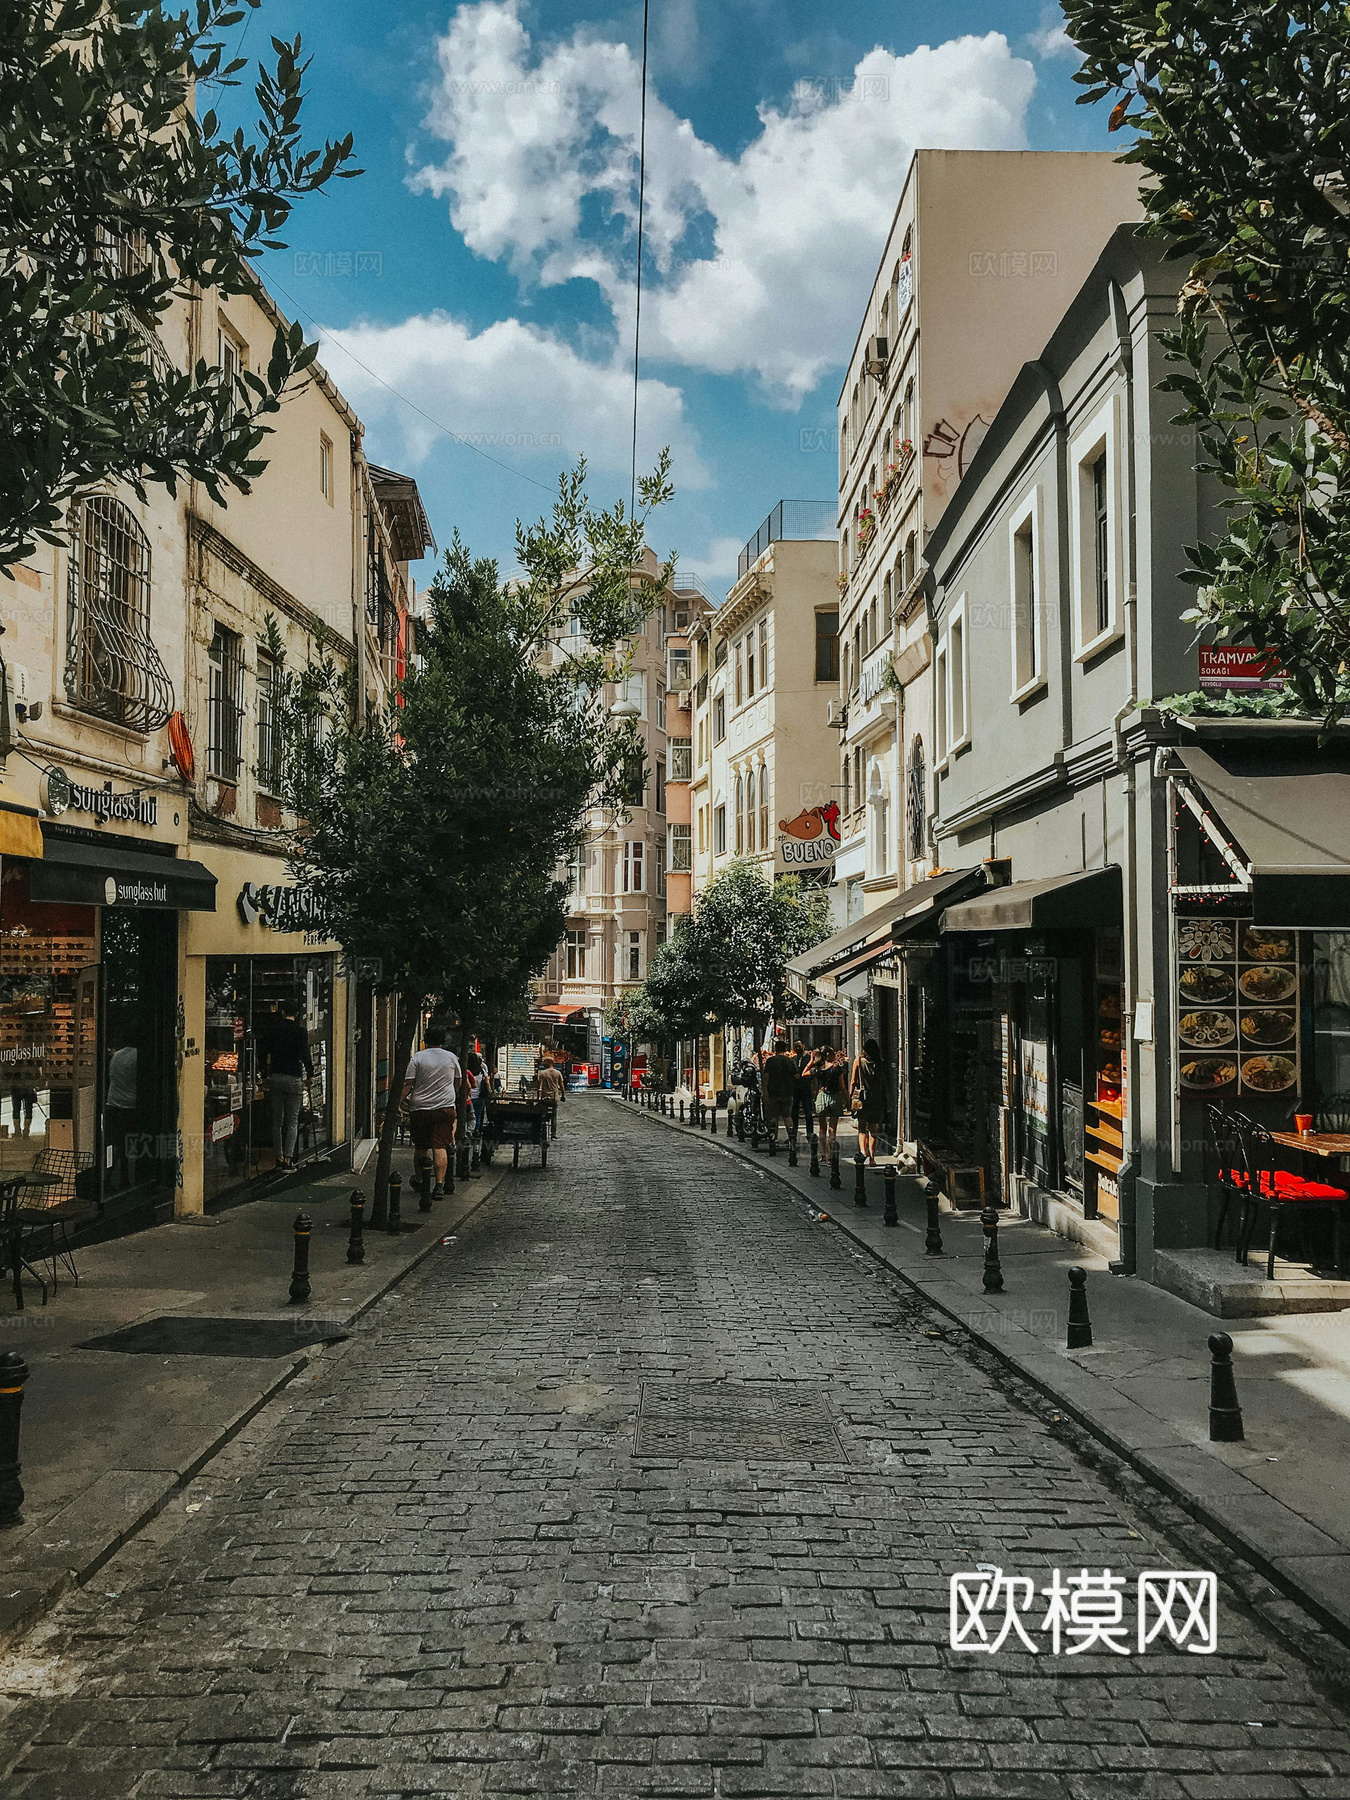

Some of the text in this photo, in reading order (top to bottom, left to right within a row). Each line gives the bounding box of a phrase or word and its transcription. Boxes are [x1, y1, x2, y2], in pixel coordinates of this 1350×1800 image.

[1201, 667, 1230, 675] SOKAĞI
[72, 783, 158, 826] sunglass hut
[782, 838, 837, 863] BUENO
[118, 881, 167, 905] sunglass hut
[32, 1041, 46, 1058] hut
